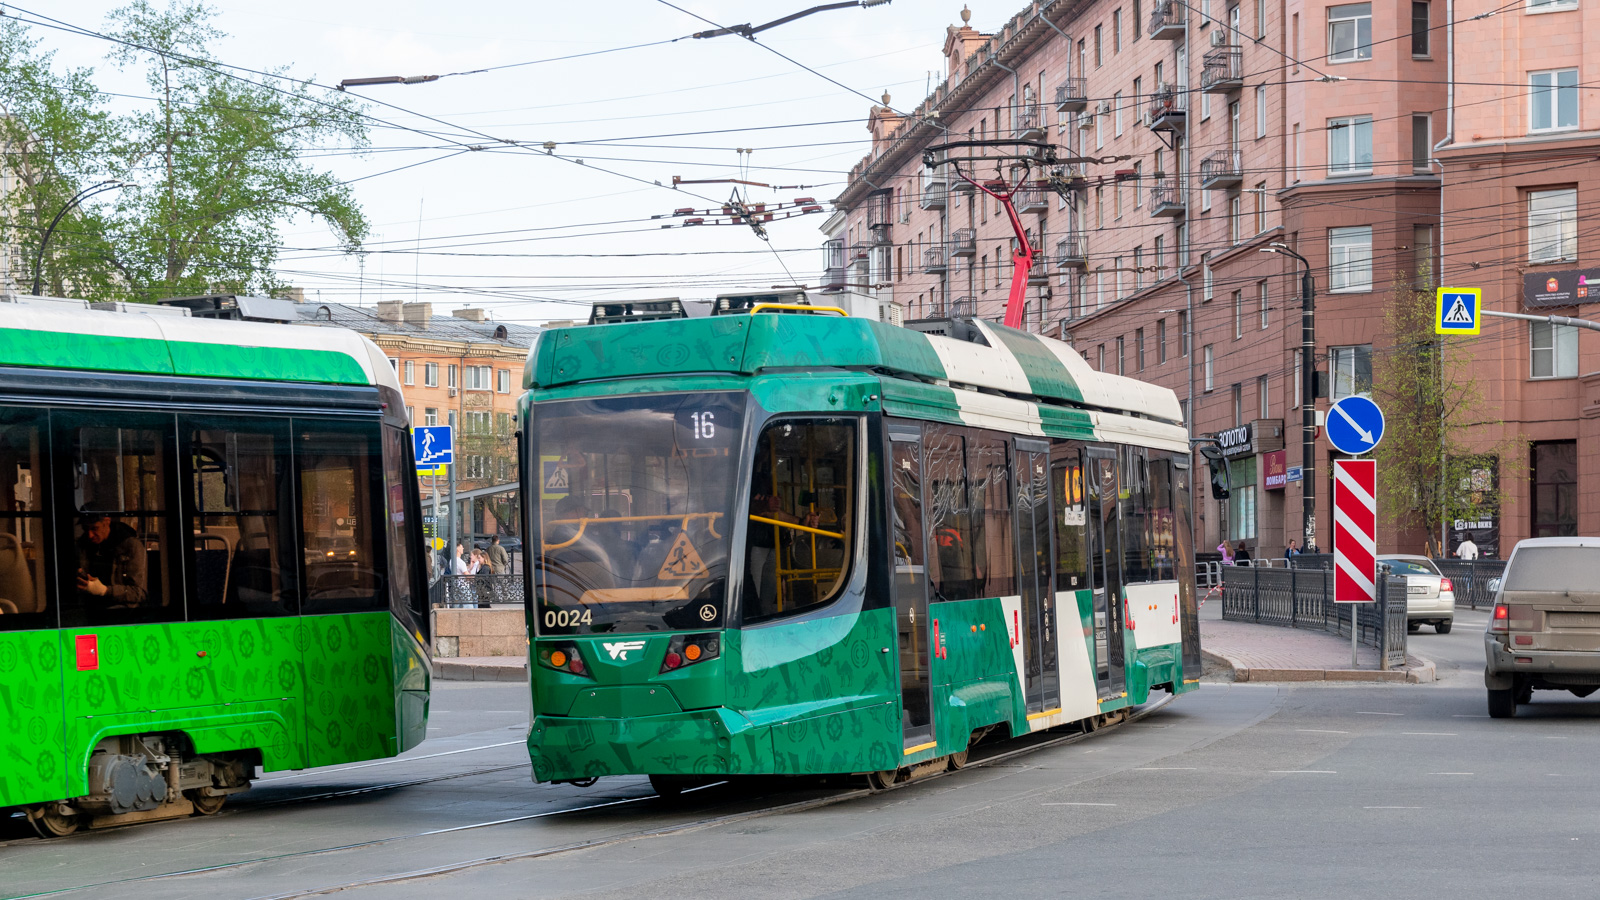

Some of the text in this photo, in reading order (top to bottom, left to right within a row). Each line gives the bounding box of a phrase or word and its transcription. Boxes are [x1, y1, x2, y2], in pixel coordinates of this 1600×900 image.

[691, 411, 715, 439] 16
[1219, 427, 1247, 448] ЗОЛОТКО
[544, 609, 593, 628] 0024
